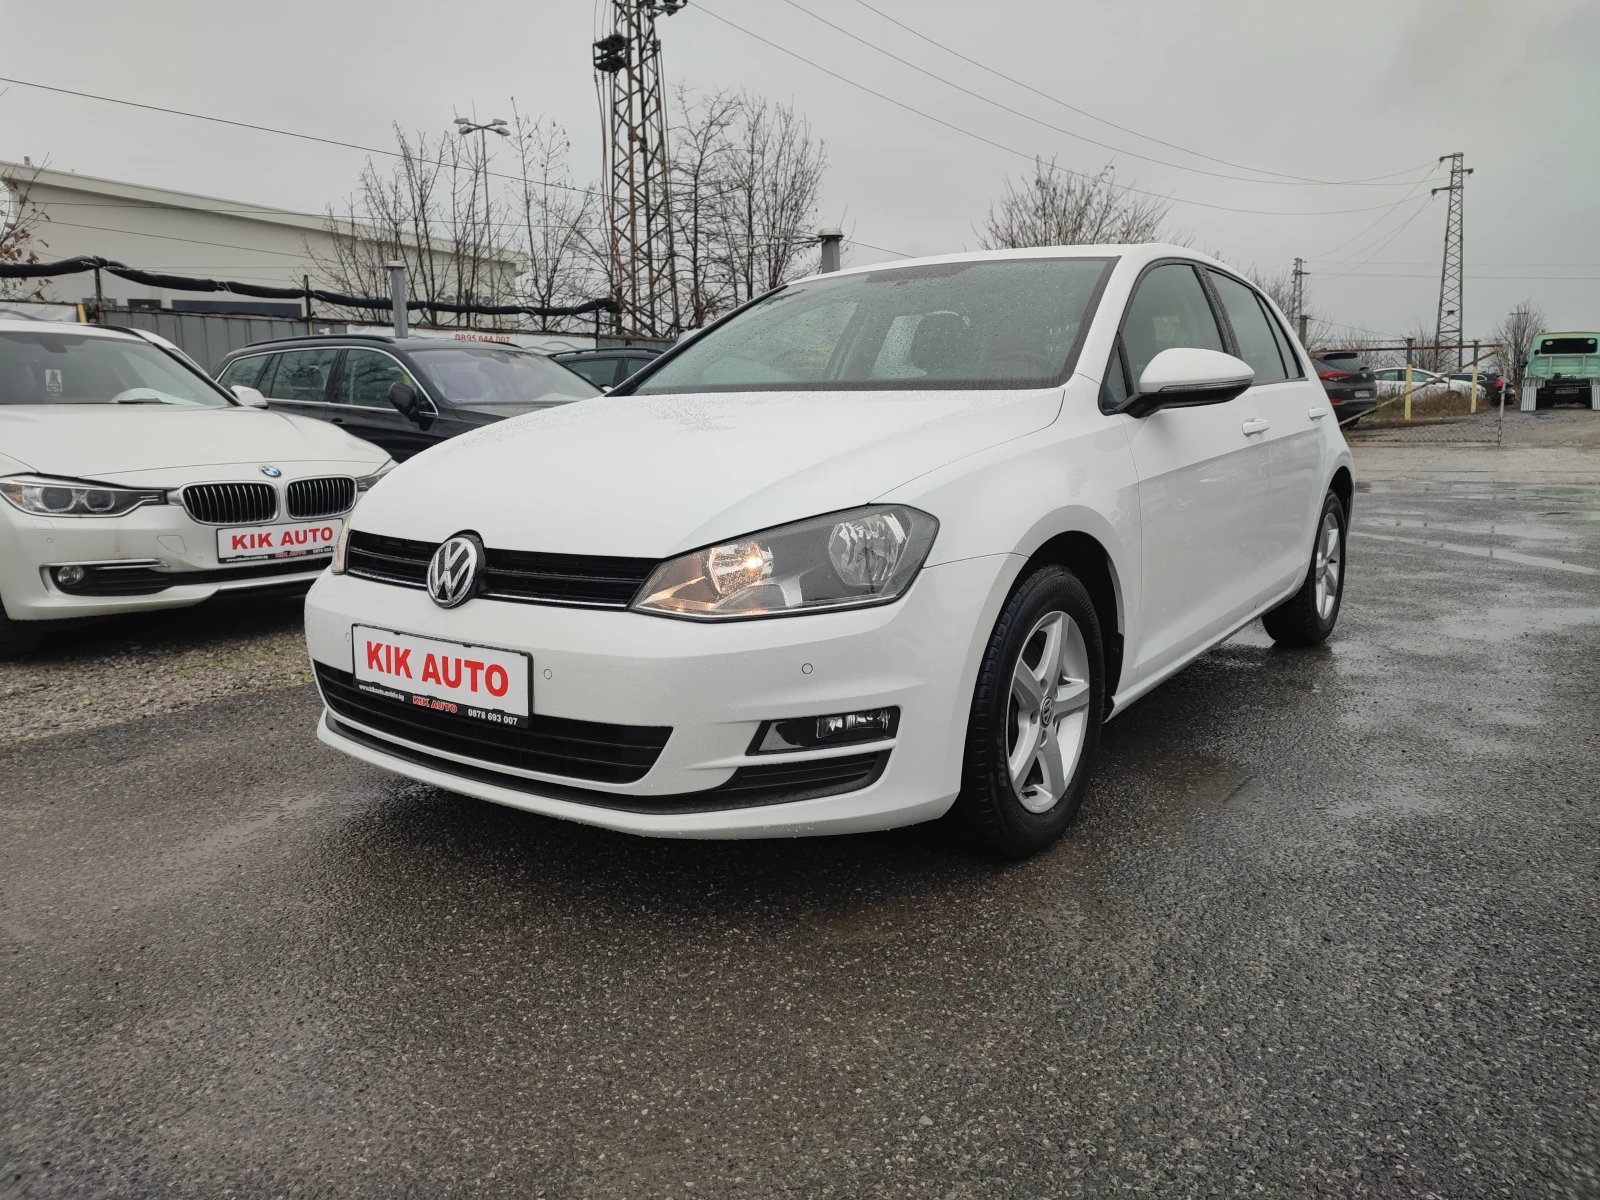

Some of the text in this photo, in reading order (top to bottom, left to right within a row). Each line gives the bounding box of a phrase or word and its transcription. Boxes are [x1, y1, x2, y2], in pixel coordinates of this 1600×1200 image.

[455, 333, 477, 341] 0895
[231, 526, 333, 550] KIK AUTO
[366, 640, 509, 697] KIK AUTO
[412, 695, 457, 713] KIK AUTO
[467, 708, 518, 726] 0878 693 007
